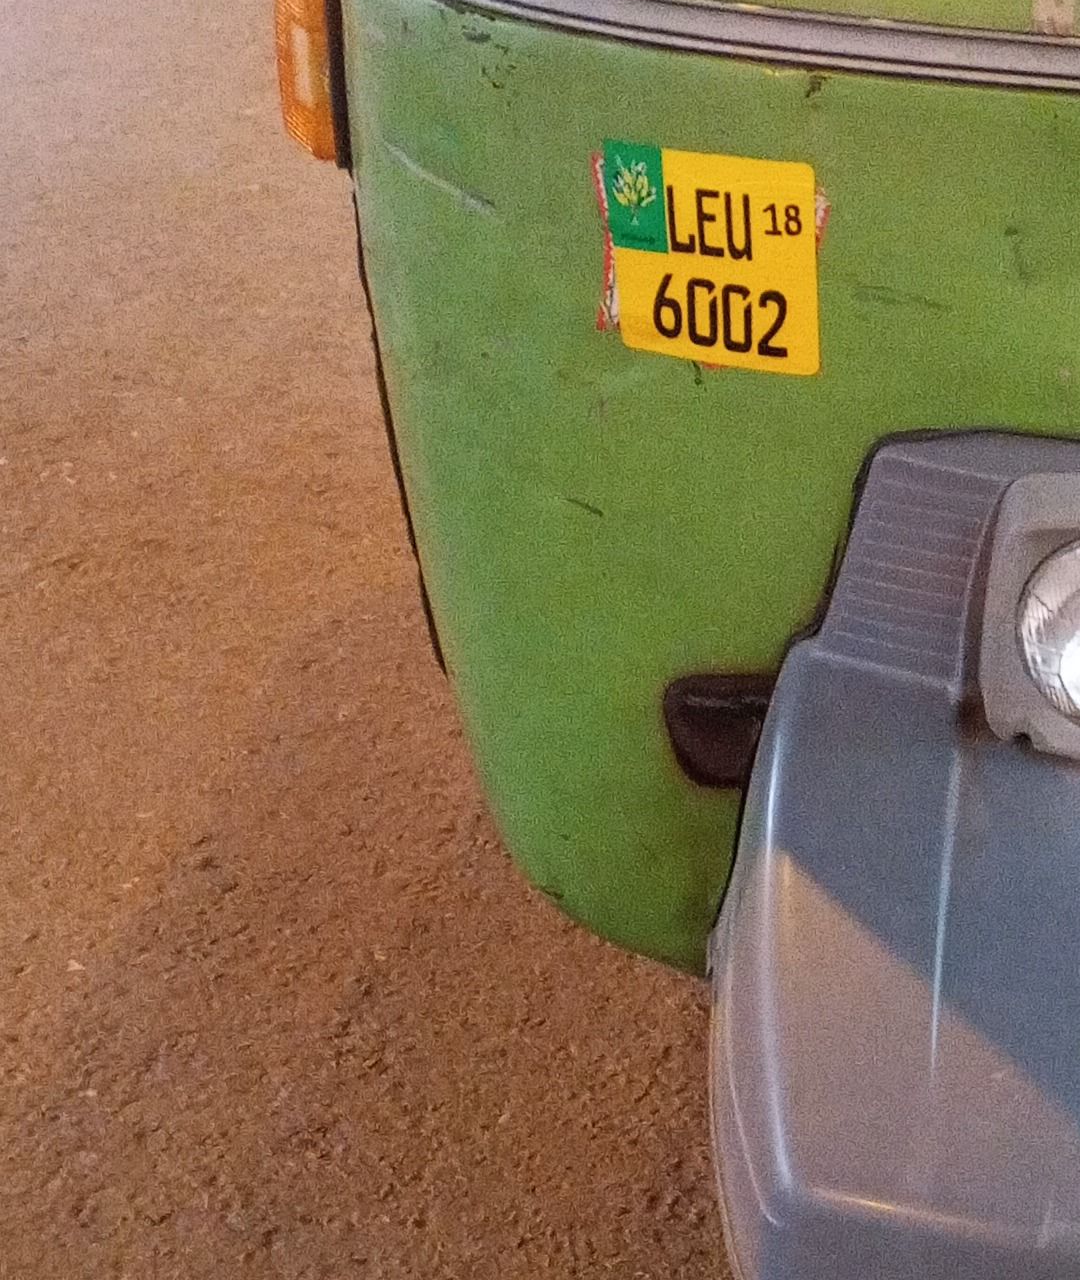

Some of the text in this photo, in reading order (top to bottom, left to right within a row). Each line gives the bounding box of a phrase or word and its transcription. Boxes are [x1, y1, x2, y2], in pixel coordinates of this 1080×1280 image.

[666, 185, 803, 261] LEU 18
[652, 273, 788, 358] 6002
